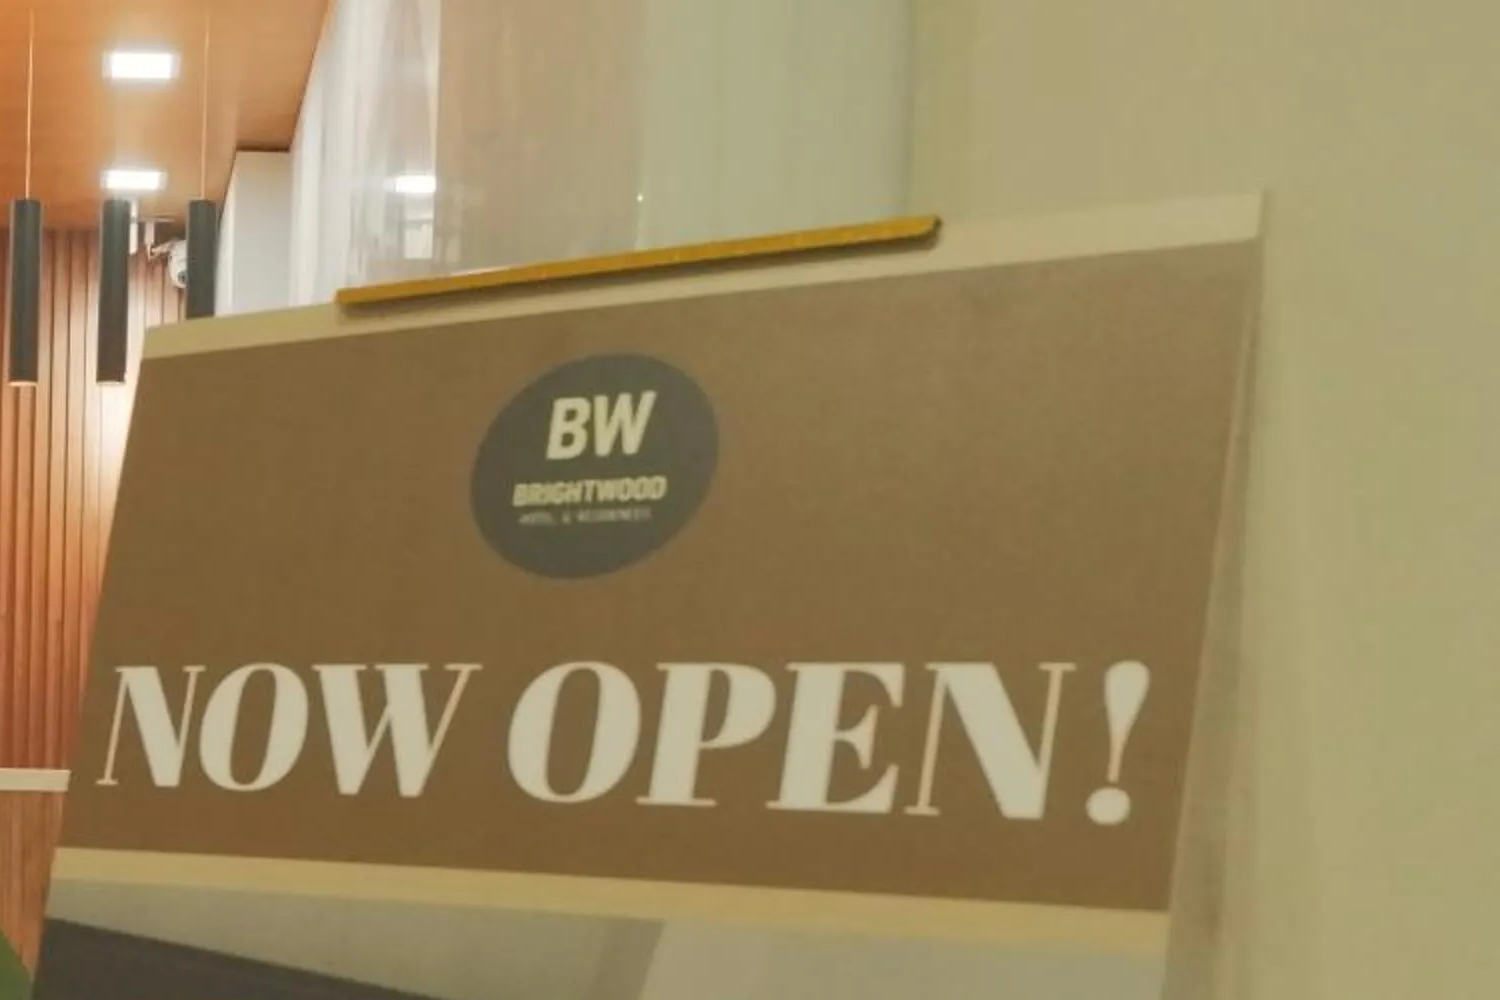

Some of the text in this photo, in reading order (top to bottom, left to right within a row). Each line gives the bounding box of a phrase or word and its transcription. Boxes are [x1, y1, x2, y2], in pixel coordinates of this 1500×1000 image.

[546, 390, 657, 460] BW
[96, 660, 1150, 825] NOW OPEN!
